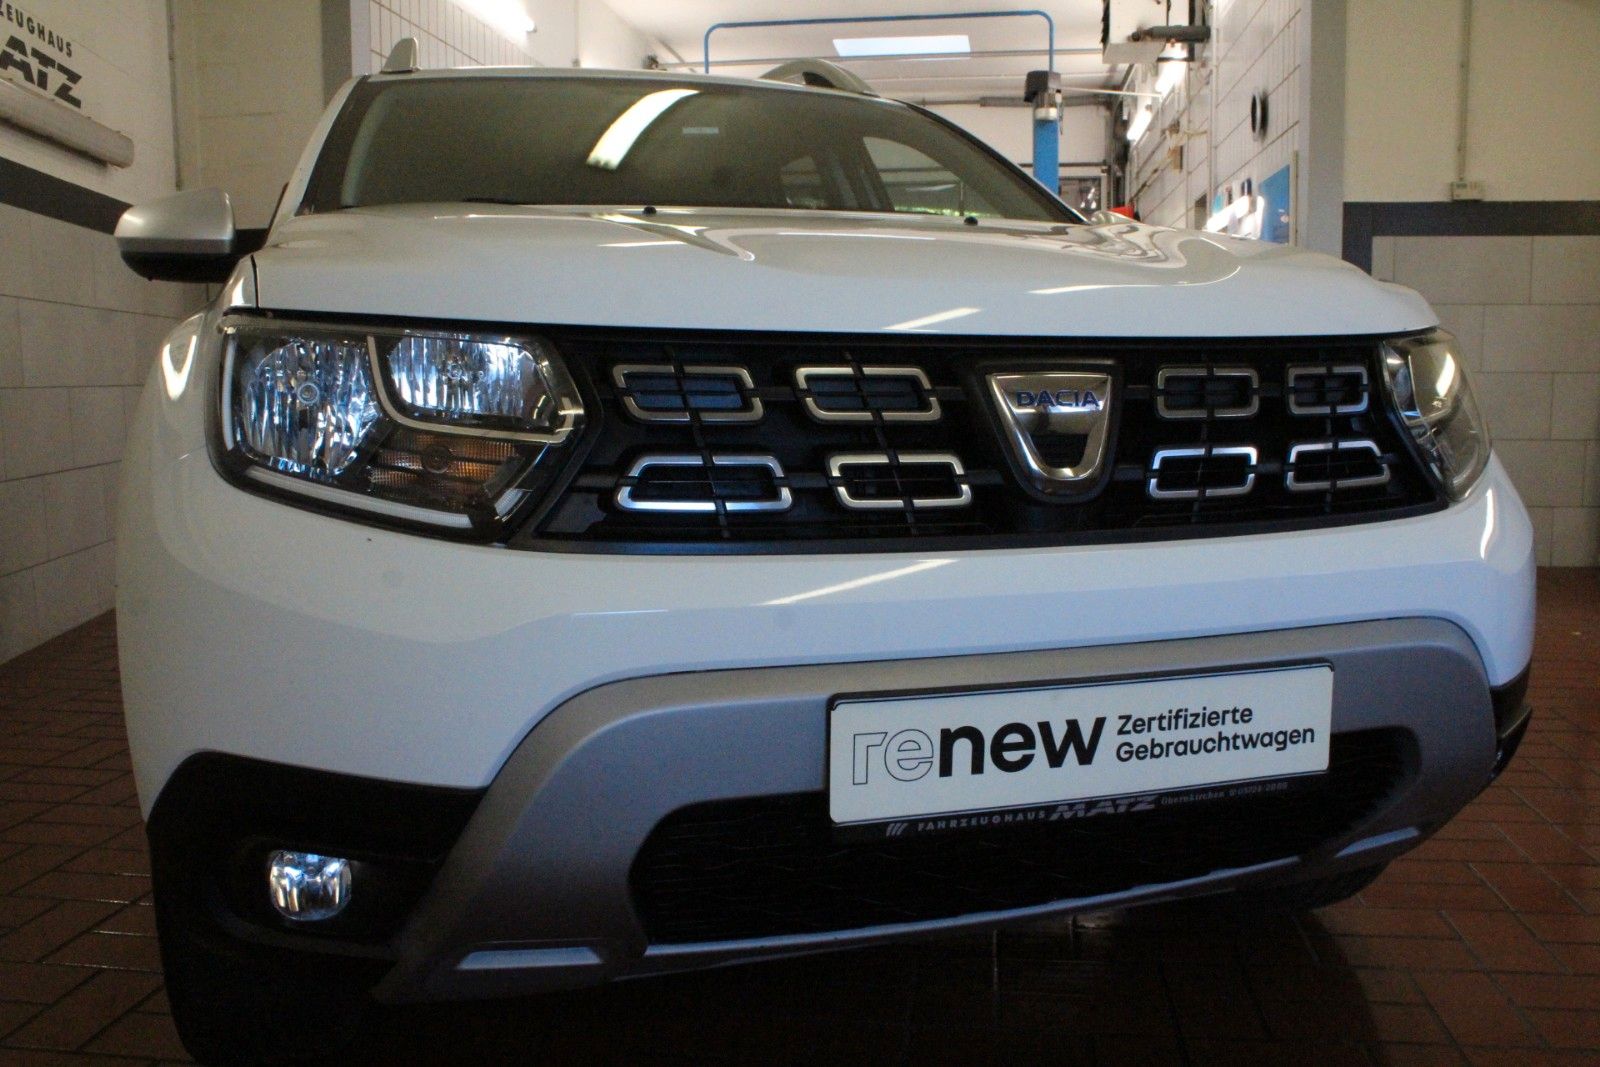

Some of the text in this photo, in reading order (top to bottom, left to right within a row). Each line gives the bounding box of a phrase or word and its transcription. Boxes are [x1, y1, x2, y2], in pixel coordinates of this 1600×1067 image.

[1016, 389, 1100, 407] DACIA
[1117, 706, 1253, 736] Zertifizierte
[853, 717, 1107, 785] renew
[1116, 727, 1315, 762] Gebrauchtwagen
[917, 810, 1046, 832] FAHRZEUGHAUS
[1050, 795, 1156, 821] MATZ
